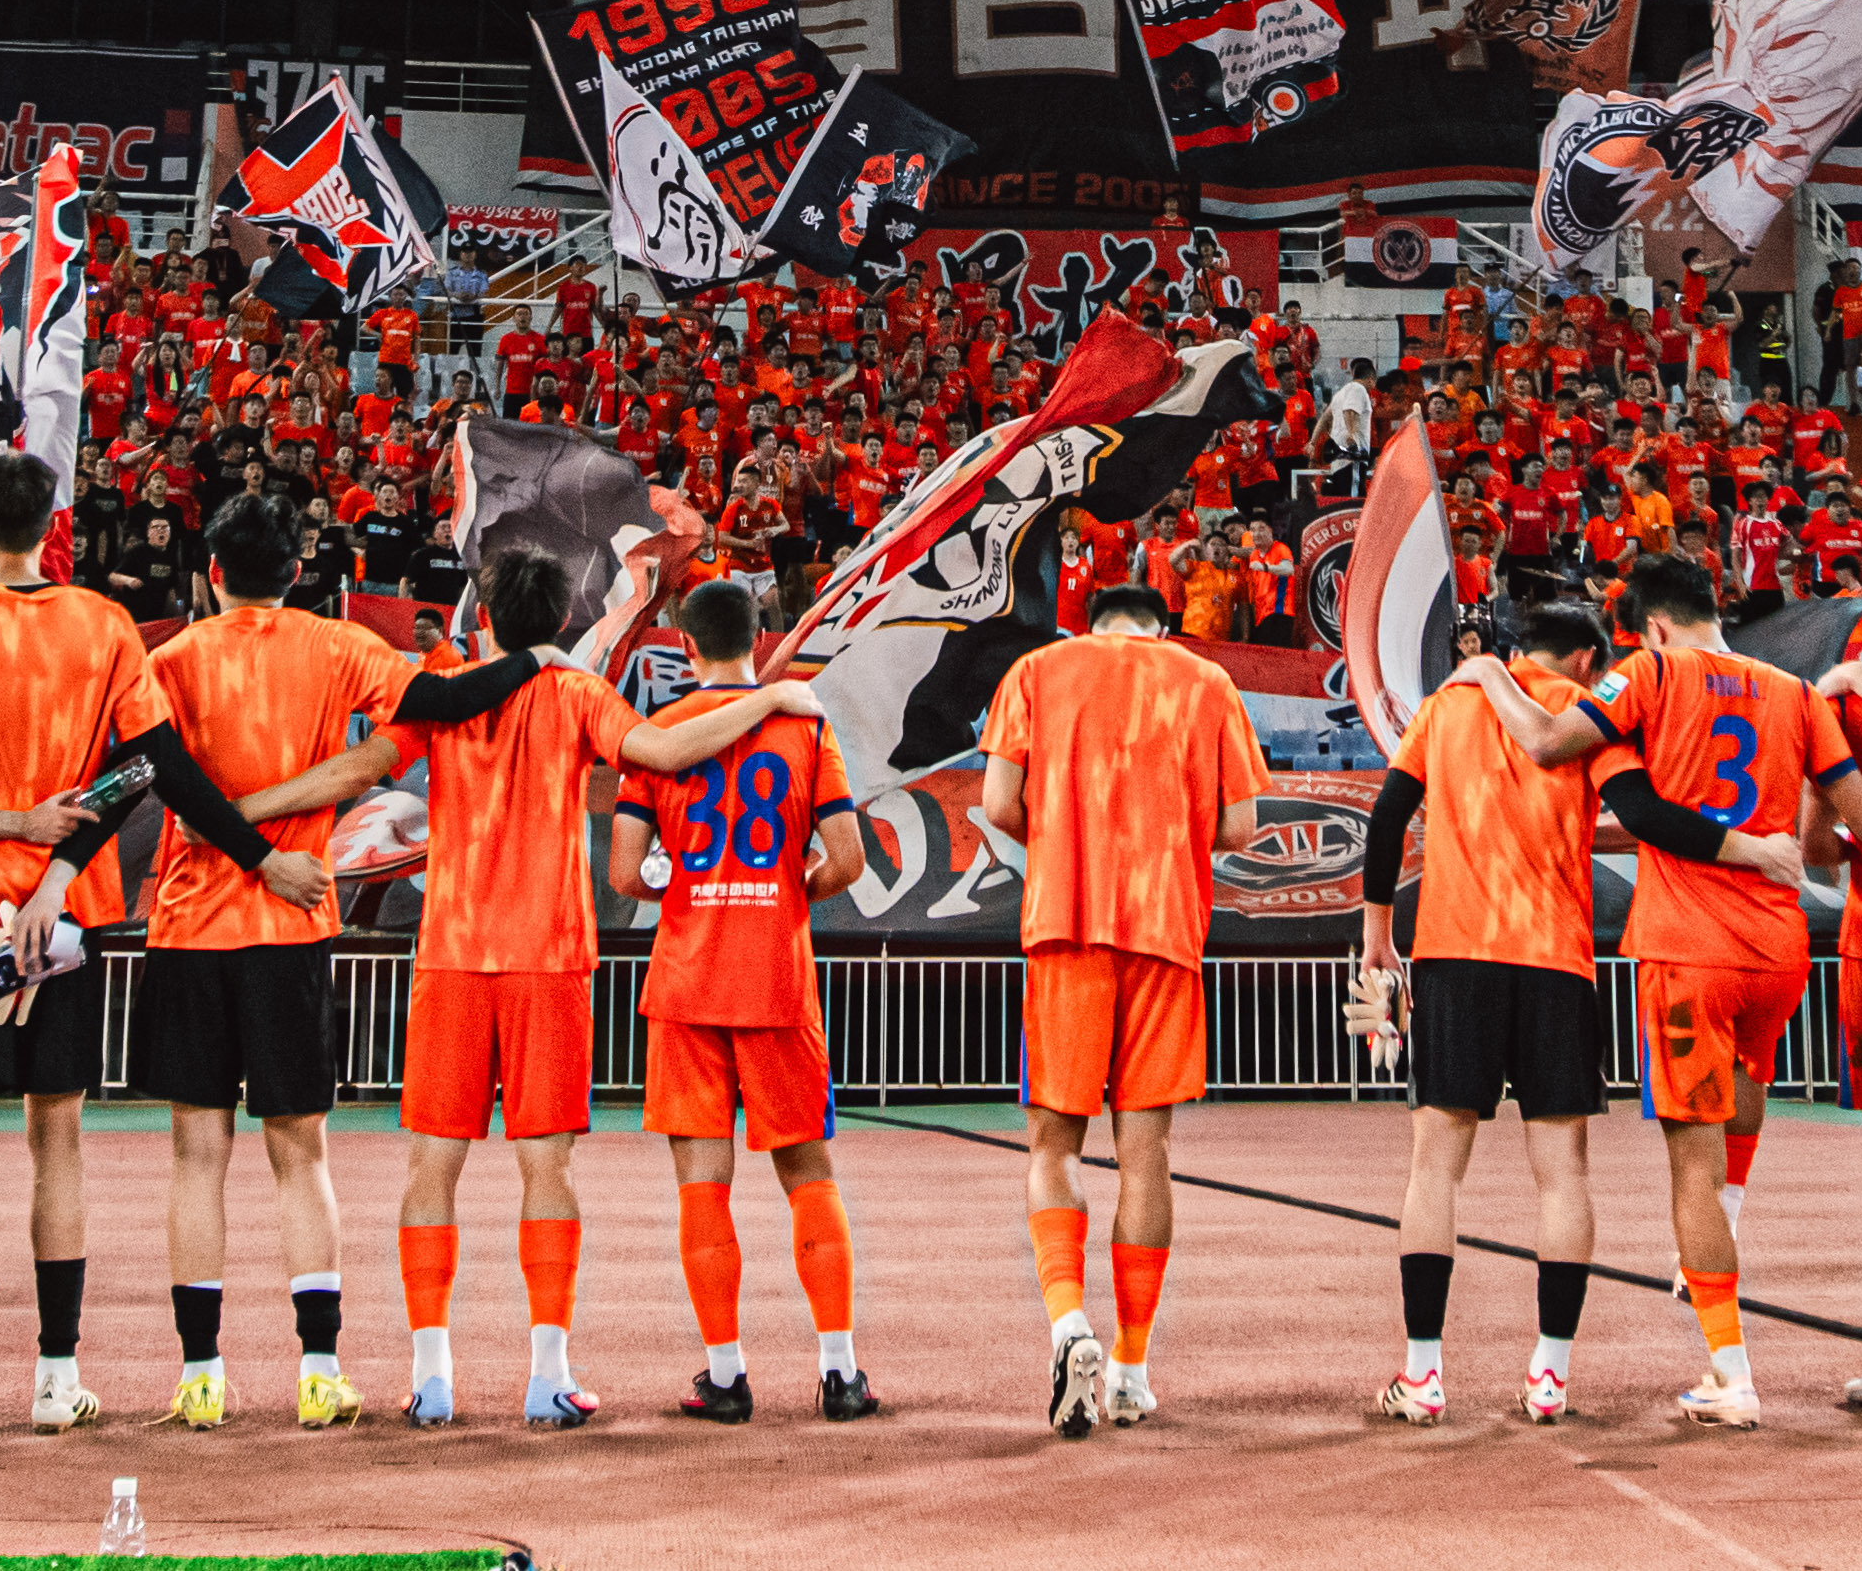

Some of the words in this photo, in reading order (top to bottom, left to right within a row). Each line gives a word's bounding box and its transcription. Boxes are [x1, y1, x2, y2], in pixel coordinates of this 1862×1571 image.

[576, 41, 696, 96] SHNDONG
[699, 7, 796, 44] TAISHAN
[653, 49, 818, 151] 005
[749, 117, 778, 141] OF
[785, 88, 838, 122] TIME
[676, 751, 789, 872] 38
[1701, 715, 1758, 829] 3
